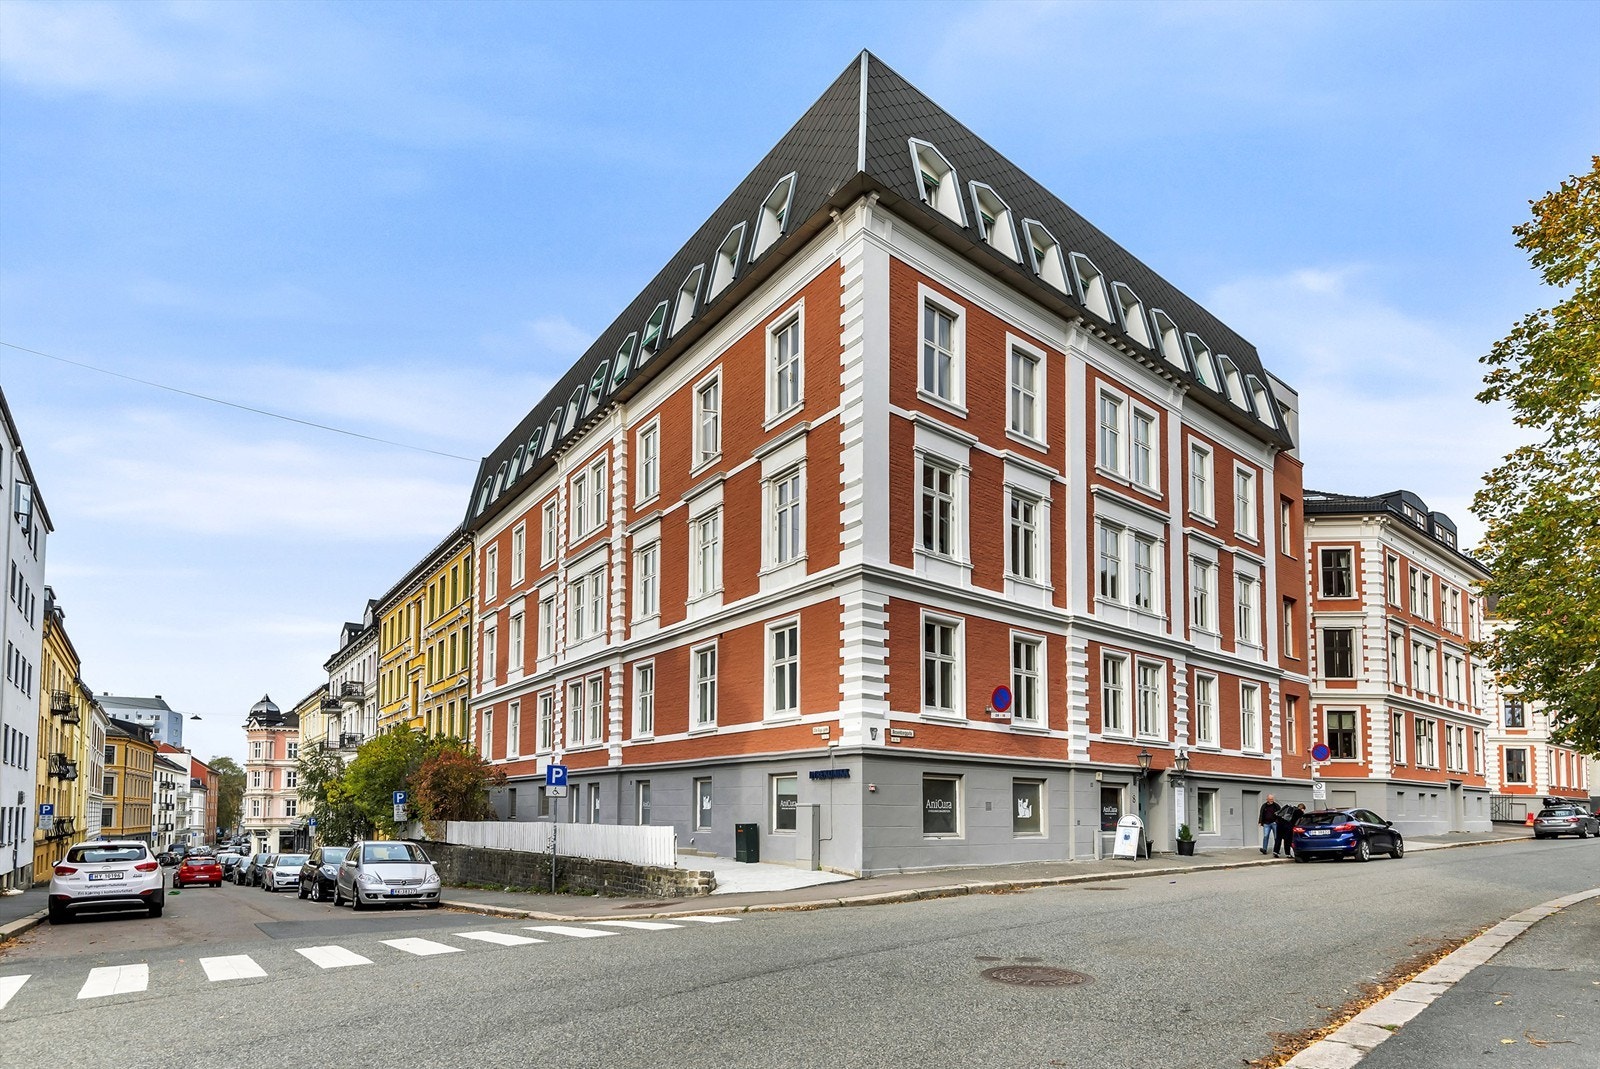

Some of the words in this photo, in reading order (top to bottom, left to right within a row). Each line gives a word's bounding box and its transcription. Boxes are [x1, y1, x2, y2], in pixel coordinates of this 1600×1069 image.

[552, 767, 564, 784] P
[396, 792, 405, 803] P
[925, 799, 952, 809] AniCura
[42, 805, 51, 814] P
